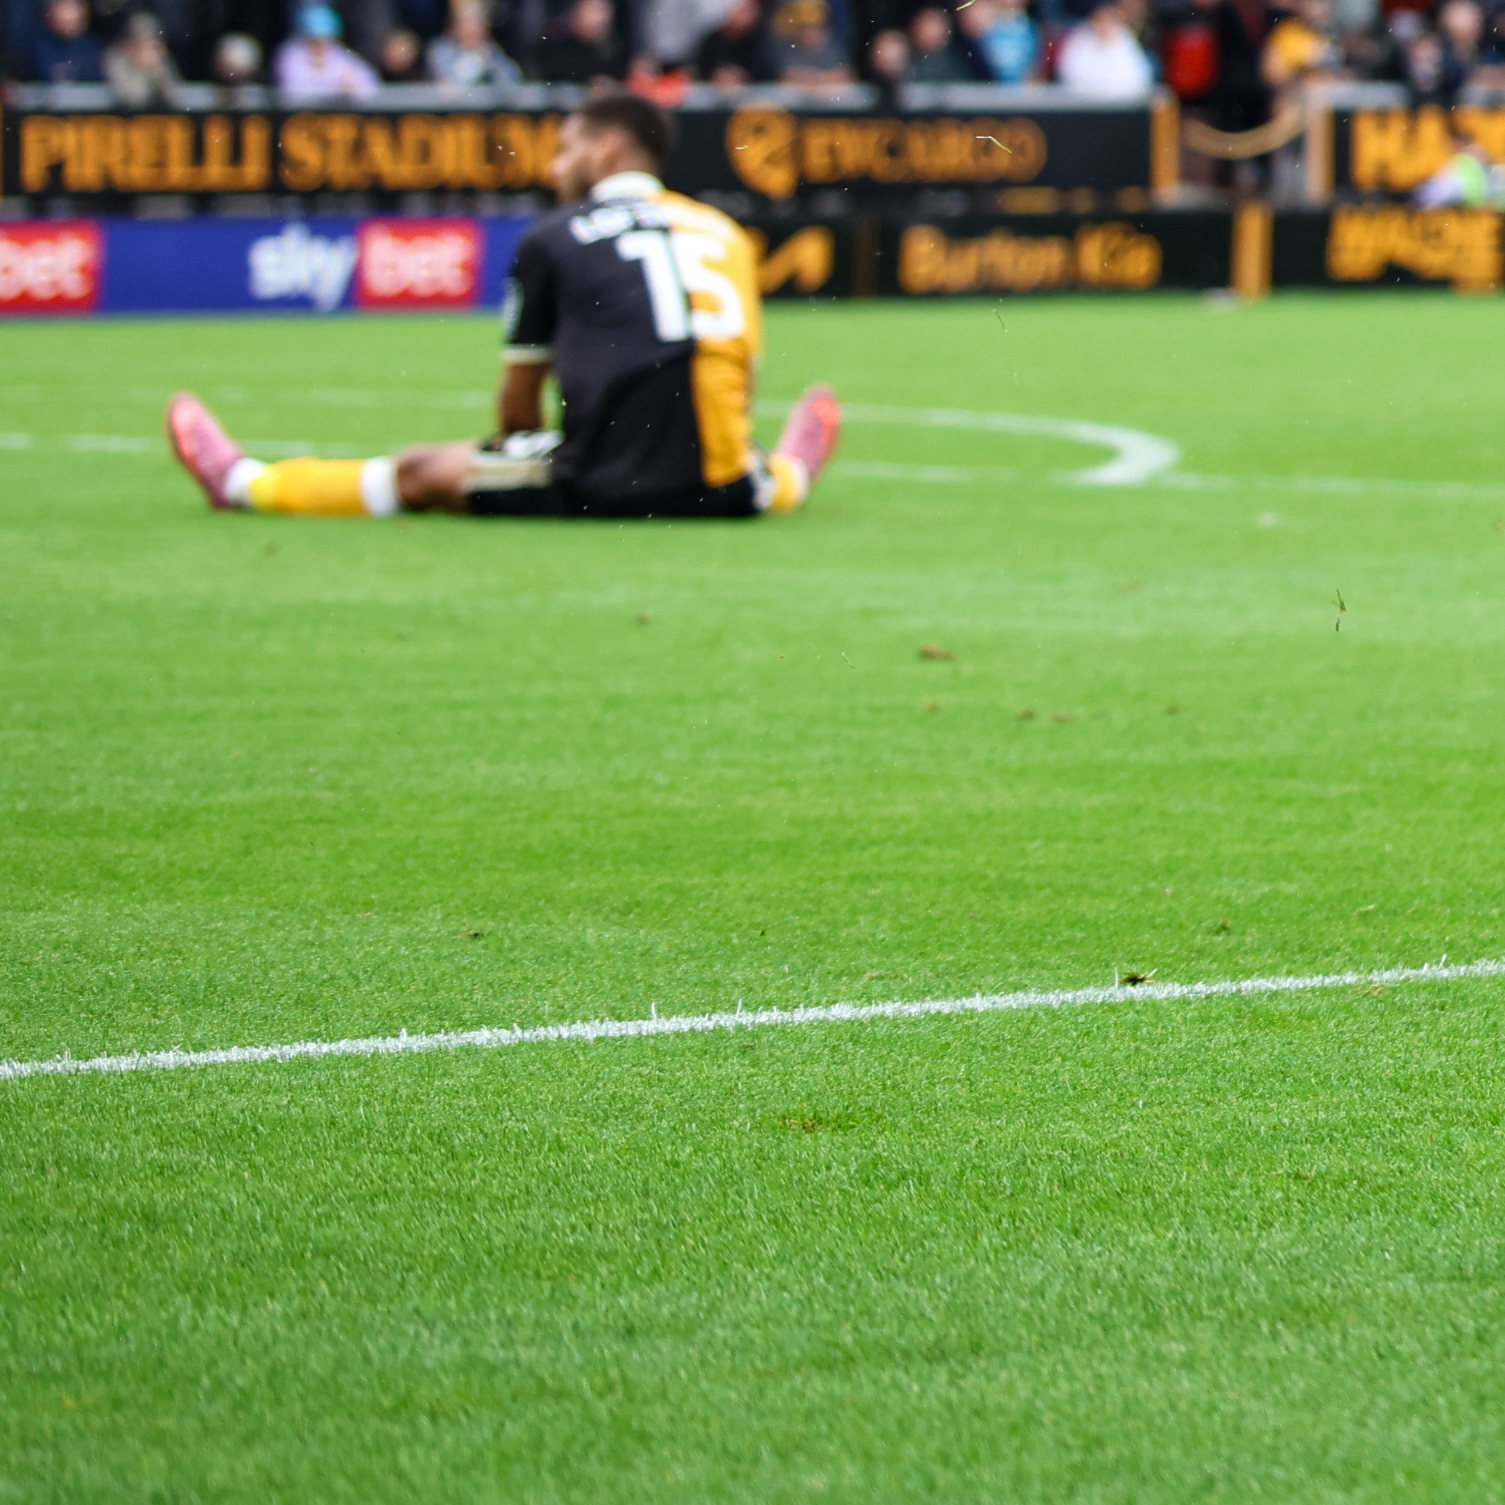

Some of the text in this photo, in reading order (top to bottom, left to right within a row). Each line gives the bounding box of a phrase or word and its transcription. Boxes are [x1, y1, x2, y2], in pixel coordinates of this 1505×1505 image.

[20, 113, 271, 192] PIRELLI
[248, 222, 357, 310] sky
[363, 225, 478, 298] bet
[616, 231, 745, 341] 15
